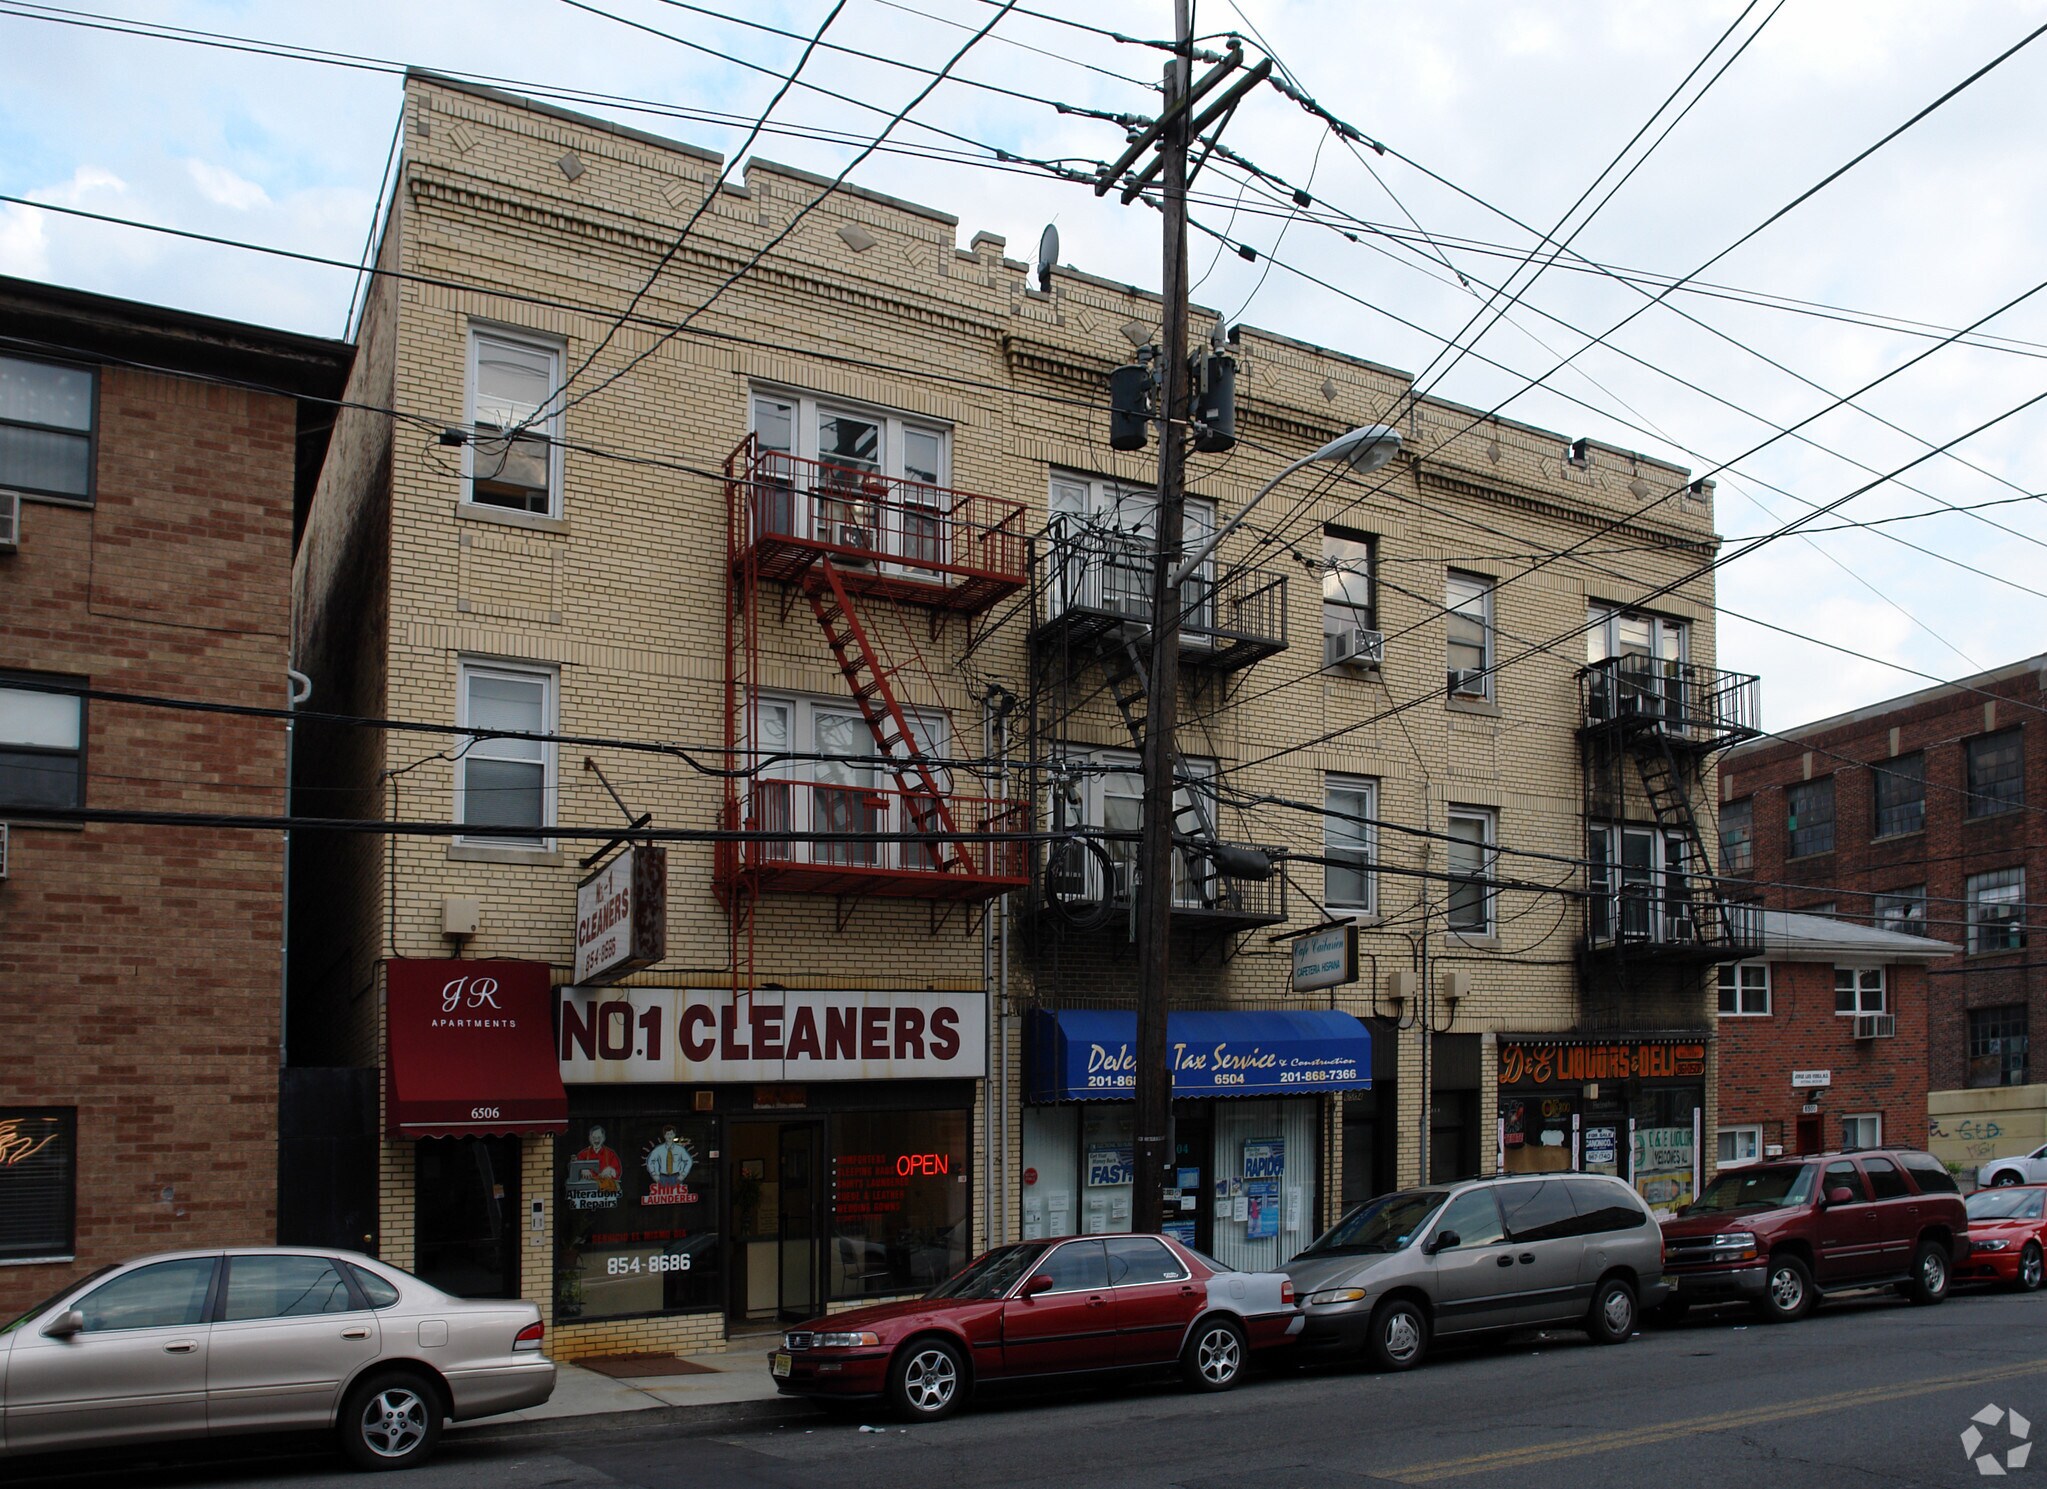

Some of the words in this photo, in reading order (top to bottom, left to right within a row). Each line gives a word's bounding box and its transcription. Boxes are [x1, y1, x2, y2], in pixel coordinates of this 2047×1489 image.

[578, 887, 630, 948] CLEANERS
[1297, 964, 1320, 978] CAFETERIA
[1321, 960, 1341, 973] HISPANA
[431, 1018, 517, 1029] APARTMENTS
[561, 1000, 662, 1061] NO.1
[679, 1003, 961, 1063] CLEANERS
[1174, 1043, 1207, 1072] Tax
[1211, 1042, 1277, 1072] Service
[1290, 1057, 1356, 1067] Construction
[1557, 1045, 1630, 1081] LIQUORS
[1638, 1044, 1676, 1078] DELI
[1214, 1073, 1245, 1085] 6504
[1280, 1069, 1357, 1083] 201-868-7366
[471, 1107, 500, 1119] 6506
[896, 1153, 949, 1177] OPEN
[566, 1188, 622, 1200] Alterations
[649, 1183, 688, 1196] Shirts
[570, 1200, 577, 1209] &
[579, 1197, 617, 1211] Repairs
[641, 1193, 699, 1206] LAUNDERED
[607, 1253, 691, 1275] 854-8686
